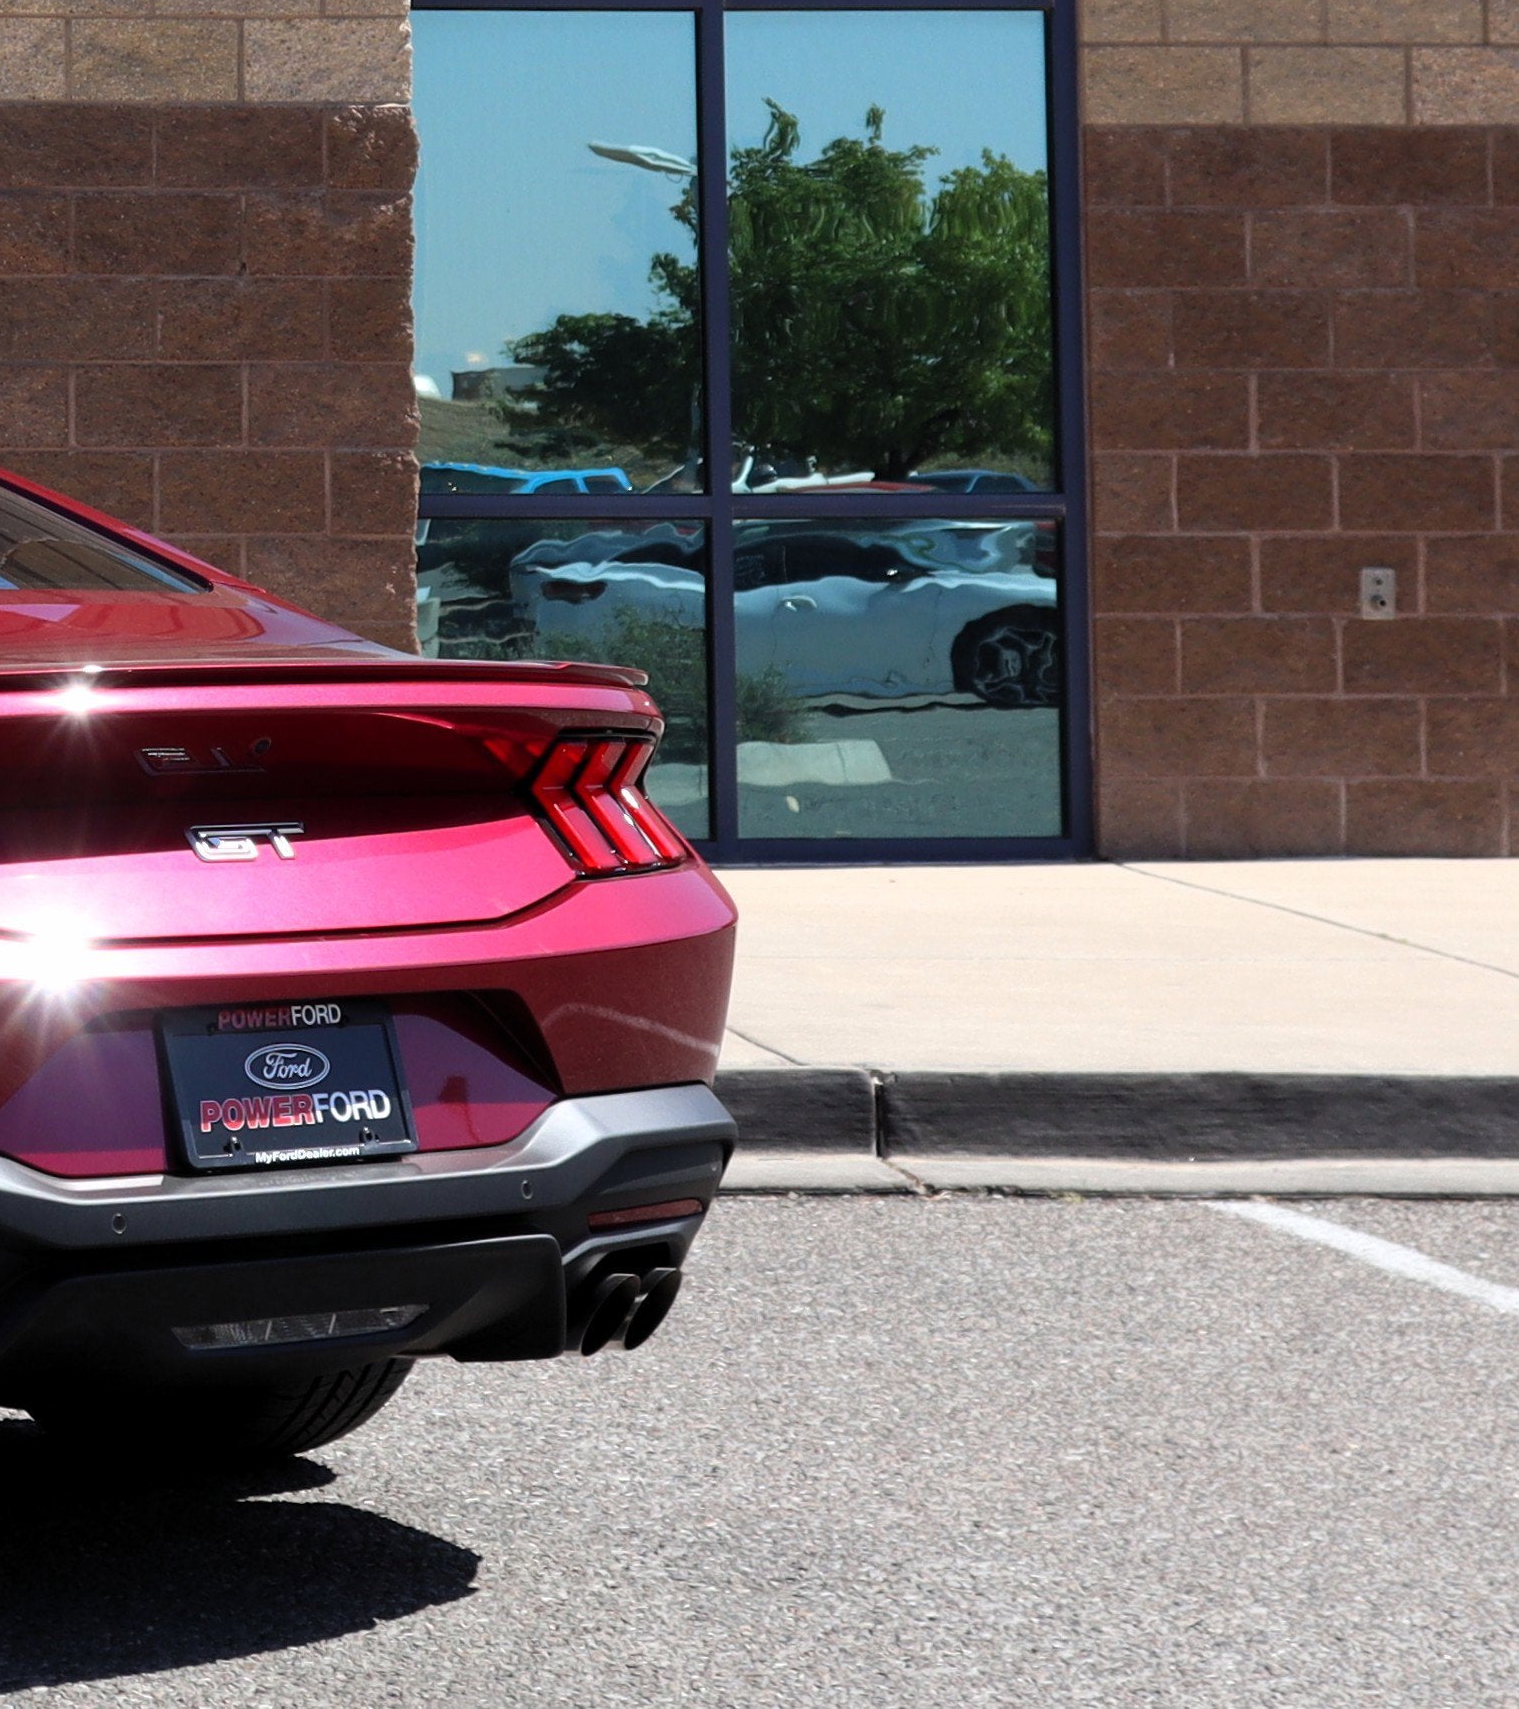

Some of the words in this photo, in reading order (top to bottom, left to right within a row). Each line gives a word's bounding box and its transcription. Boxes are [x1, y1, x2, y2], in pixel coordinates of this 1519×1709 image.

[184, 822, 305, 863] GT
[218, 1003, 342, 1030] POWERFORD
[263, 1051, 313, 1079] Ford
[200, 1089, 392, 1133] POWERFORD
[255, 1146, 361, 1164] MyFordDealer.com
